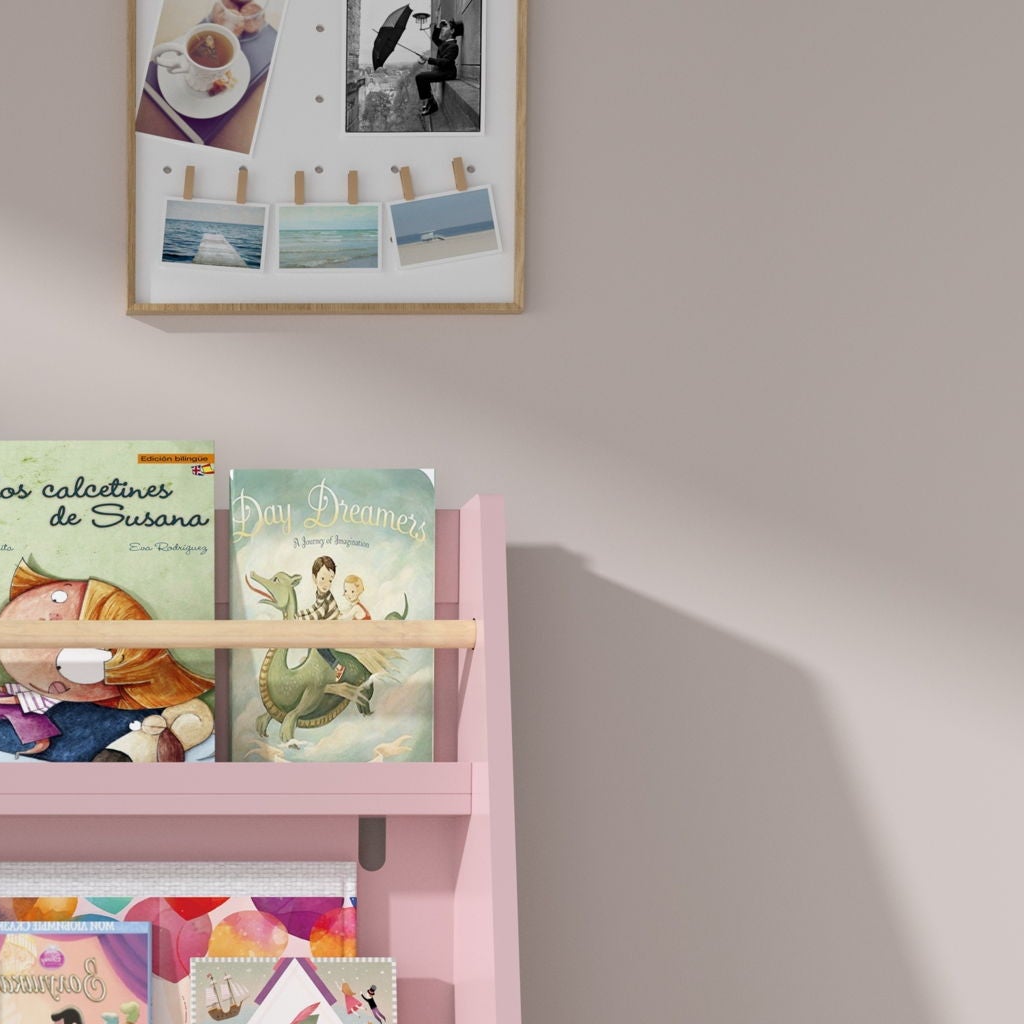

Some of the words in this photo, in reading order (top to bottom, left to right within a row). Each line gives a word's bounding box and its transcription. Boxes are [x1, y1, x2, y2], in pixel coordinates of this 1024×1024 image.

[140, 455, 173, 463] Edición
[41, 475, 174, 500] calcetines
[49, 504, 82, 527] de
[90, 502, 210, 528] Susana
[231, 487, 292, 544] Day
[302, 477, 427, 543] Dreamers
[128, 542, 153, 552] Eva
